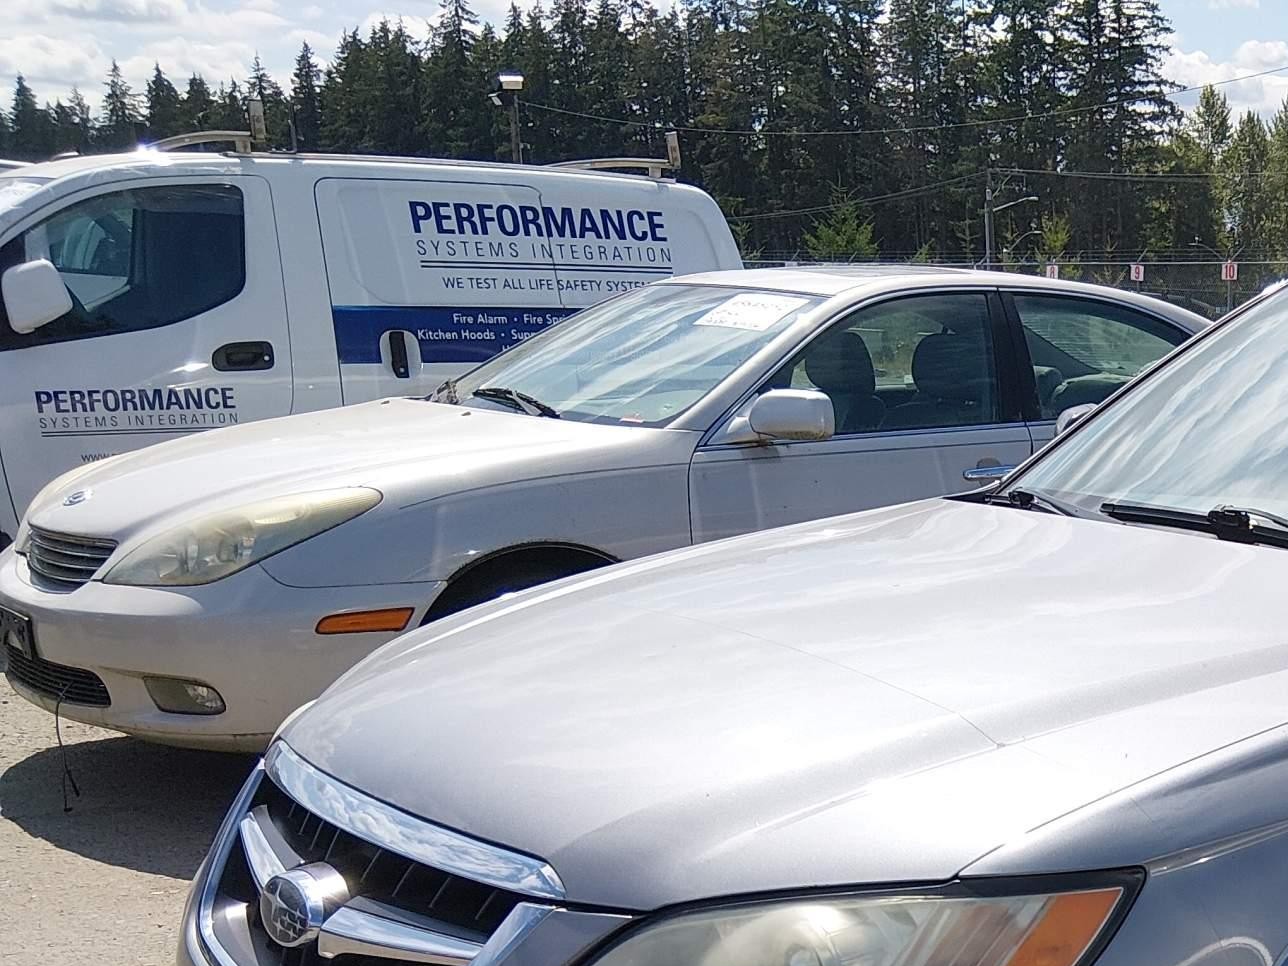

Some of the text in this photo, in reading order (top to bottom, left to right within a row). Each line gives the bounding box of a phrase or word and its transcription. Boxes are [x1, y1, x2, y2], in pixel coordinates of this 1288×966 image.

[408, 200, 668, 242] PERFORMANCE
[416, 239, 672, 263] SYSTEMS INTEGRATION
[1134, 265, 1141, 279] 9
[1223, 264, 1236, 279] 10
[442, 277, 464, 290] WE
[467, 277, 498, 290] TEST
[502, 278, 526, 290] ALL
[528, 278, 554, 290] LIFE
[557, 279, 602, 292] SAFETY
[453, 313, 474, 324] Fire
[477, 313, 508, 325] Alarm
[523, 313, 544, 325] Fire
[417, 328, 459, 341] Kitchen
[461, 329, 496, 341] Hoods
[35, 387, 236, 414] PERFORMANCE
[39, 413, 239, 429] SYSTEMS INTEGRATION
